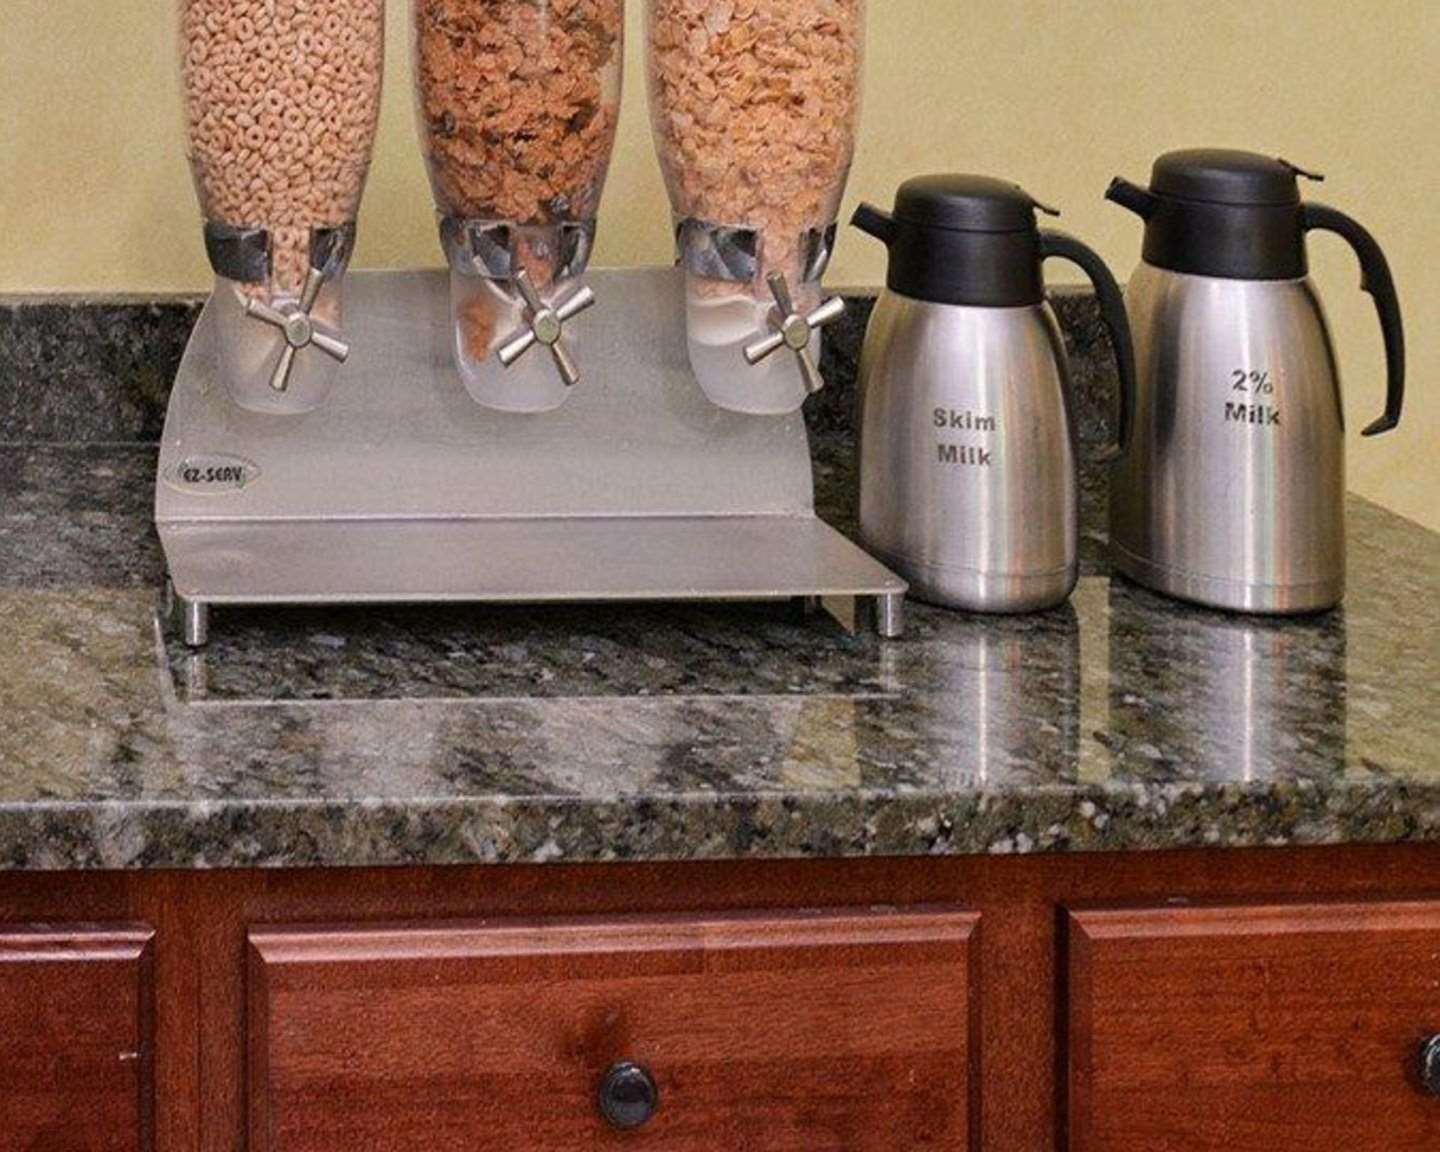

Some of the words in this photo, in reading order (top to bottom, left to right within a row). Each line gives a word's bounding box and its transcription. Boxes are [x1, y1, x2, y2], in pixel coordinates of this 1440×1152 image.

[1231, 369, 1274, 395] 2%
[933, 408, 996, 432] Skim
[1224, 402, 1280, 427] Milk
[937, 444, 991, 466] Milk
